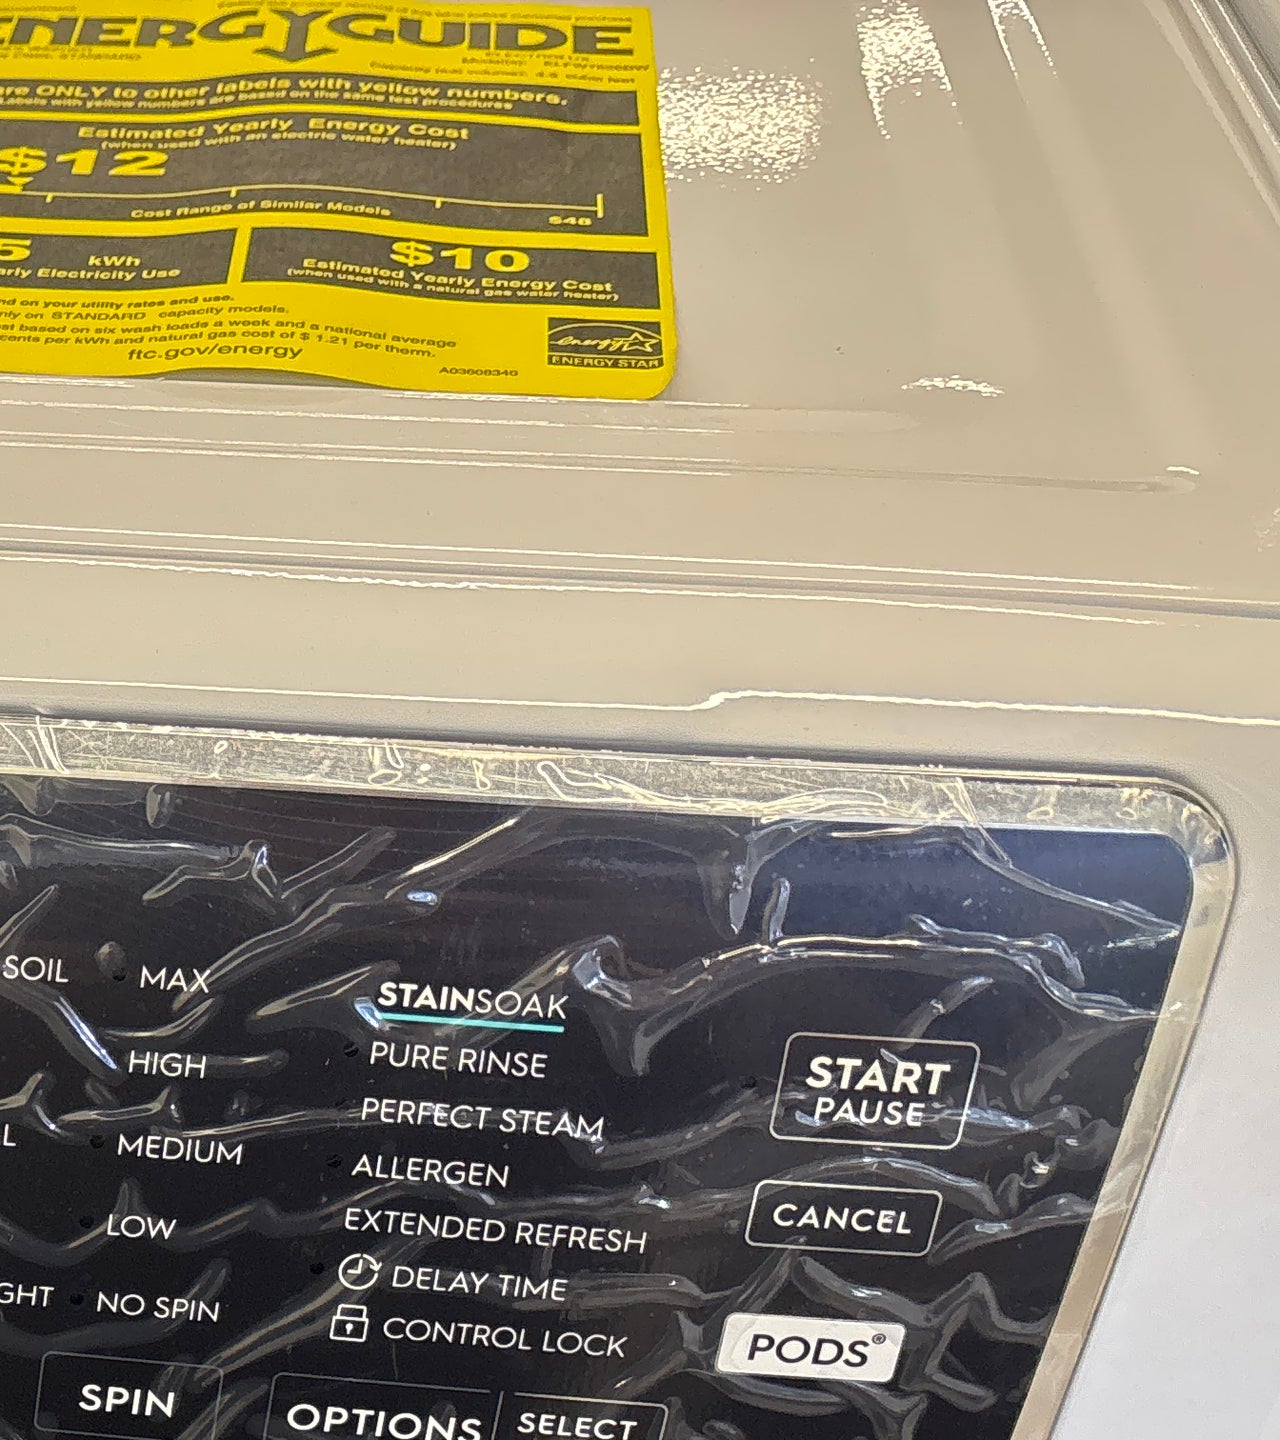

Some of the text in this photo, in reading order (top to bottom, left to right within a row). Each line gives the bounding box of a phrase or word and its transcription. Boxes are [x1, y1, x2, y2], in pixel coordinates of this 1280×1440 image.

[36, 85, 106, 99] ONLY
[113, 85, 138, 99] to
[143, 84, 211, 100] other
[216, 77, 291, 96] labels
[298, 76, 352, 91] with
[357, 79, 440, 98] yellow
[446, 88, 569, 106] numbers.
[78, 117, 469, 140] Estimated Yearly Energy Cost
[130, 200, 392, 219] Cost Range of Similar Models
[88, 255, 141, 268] kWh
[389, 239, 531, 272] $10
[37, 267, 138, 282] Electricity
[142, 268, 182, 280] Use
[303, 258, 613, 294] Estimated Yearly Energy Cost
[20, 299, 40, 308] on
[43, 300, 78, 310] your
[81, 300, 124, 311] utility
[127, 299, 166, 309] rates
[169, 295, 199, 306] and
[24, 312, 44, 320] on
[50, 310, 147, 321] STANDARD
[157, 304, 225, 320] capacity
[127, 342, 304, 361] ftc.gov/energy
[551, 356, 659, 369] ENERGY STAR
[2, 954, 69, 984] SOIL
[139, 965, 212, 995] MAX
[377, 981, 570, 1021] STAINSOAK
[127, 1049, 208, 1080] HIGH
[369, 1040, 549, 1079] PURE RINSE
[804, 1055, 952, 1096] START
[360, 1096, 606, 1142] PERFECT STEAM
[813, 1097, 927, 1129] PAUSE
[116, 1133, 244, 1167] MEDIUM
[350, 1153, 511, 1190] ALLERGEN
[105, 1213, 178, 1241] LOW
[342, 1206, 649, 1256] EXTENDED REFRESH
[771, 1203, 913, 1236] CANCEL
[390, 1264, 569, 1303] DELAY TIME
[95, 1290, 222, 1323] NO SPIN
[382, 1316, 630, 1360] CONTROL LOCK
[77, 1383, 177, 1420] SPIN
